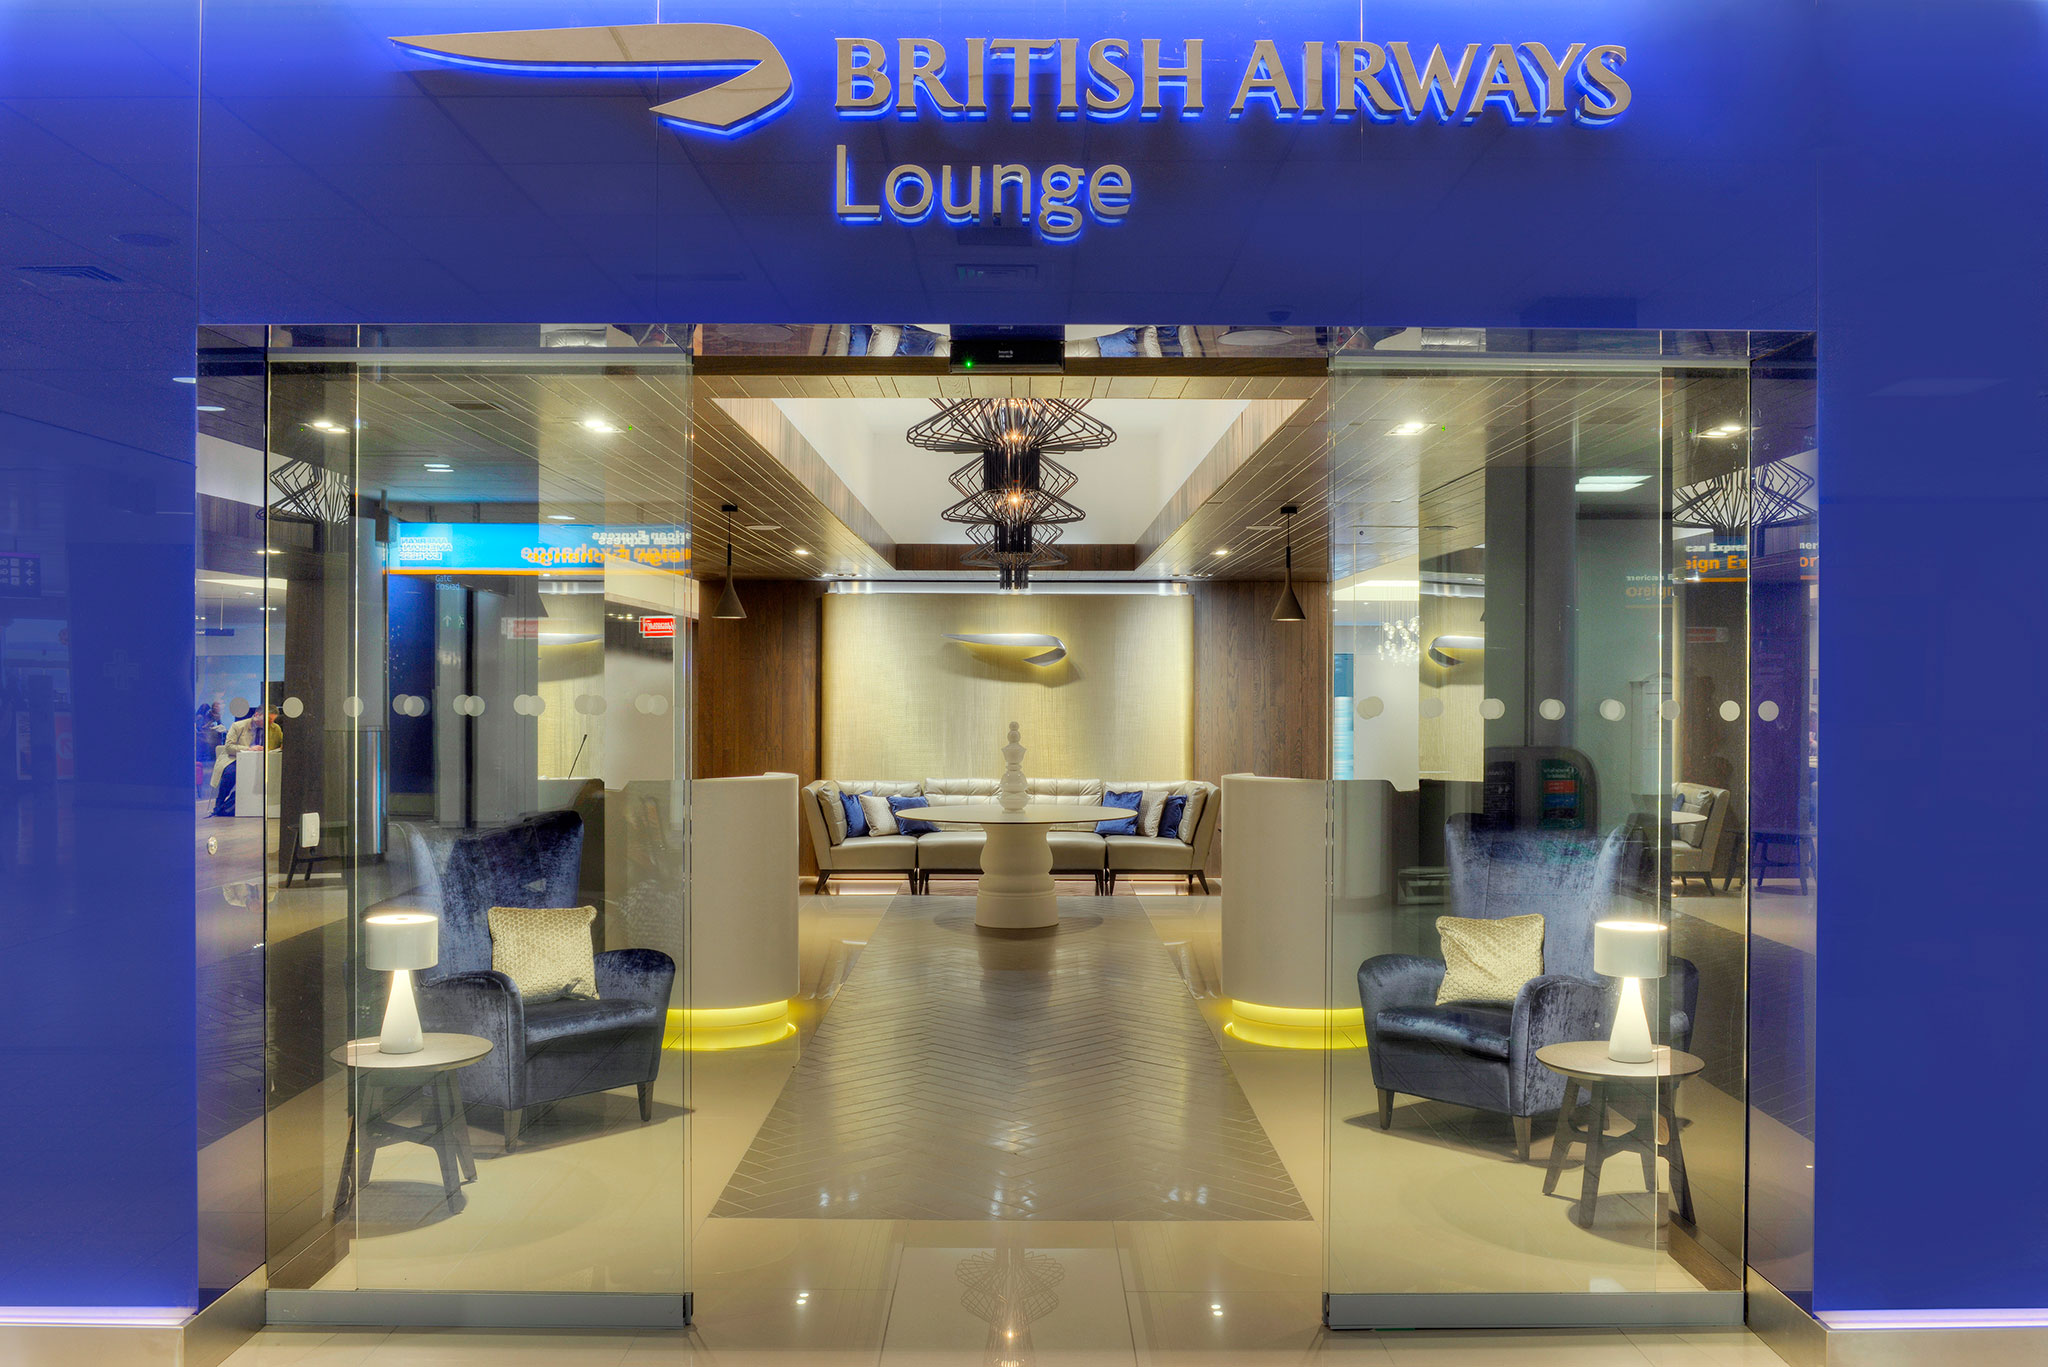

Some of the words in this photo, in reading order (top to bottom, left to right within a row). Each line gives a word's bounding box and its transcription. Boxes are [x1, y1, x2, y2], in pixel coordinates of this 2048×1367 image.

[835, 38, 1204, 115] BRITISH
[1229, 39, 1632, 118] AIRWAYS
[835, 144, 1132, 236] Lounge
